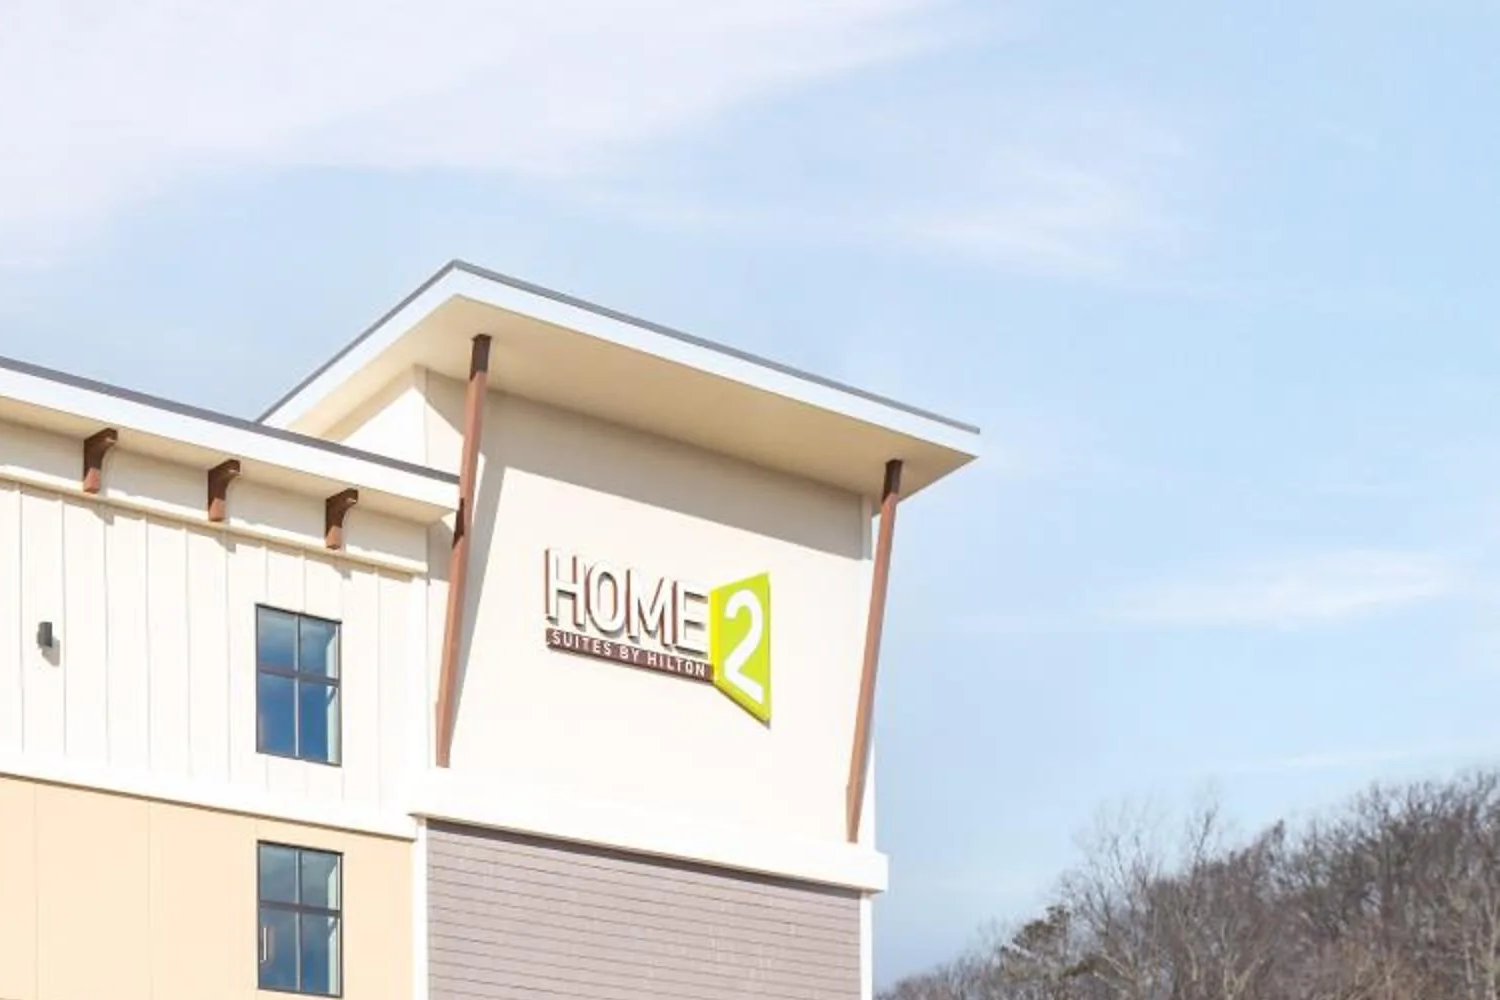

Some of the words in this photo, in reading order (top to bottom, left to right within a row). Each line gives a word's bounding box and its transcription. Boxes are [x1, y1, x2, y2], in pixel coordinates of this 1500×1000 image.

[545, 549, 709, 658] HOME
[724, 589, 764, 705] 2
[551, 631, 611, 658] SUITES
[619, 643, 640, 662] BY
[647, 653, 706, 677] HILTON
